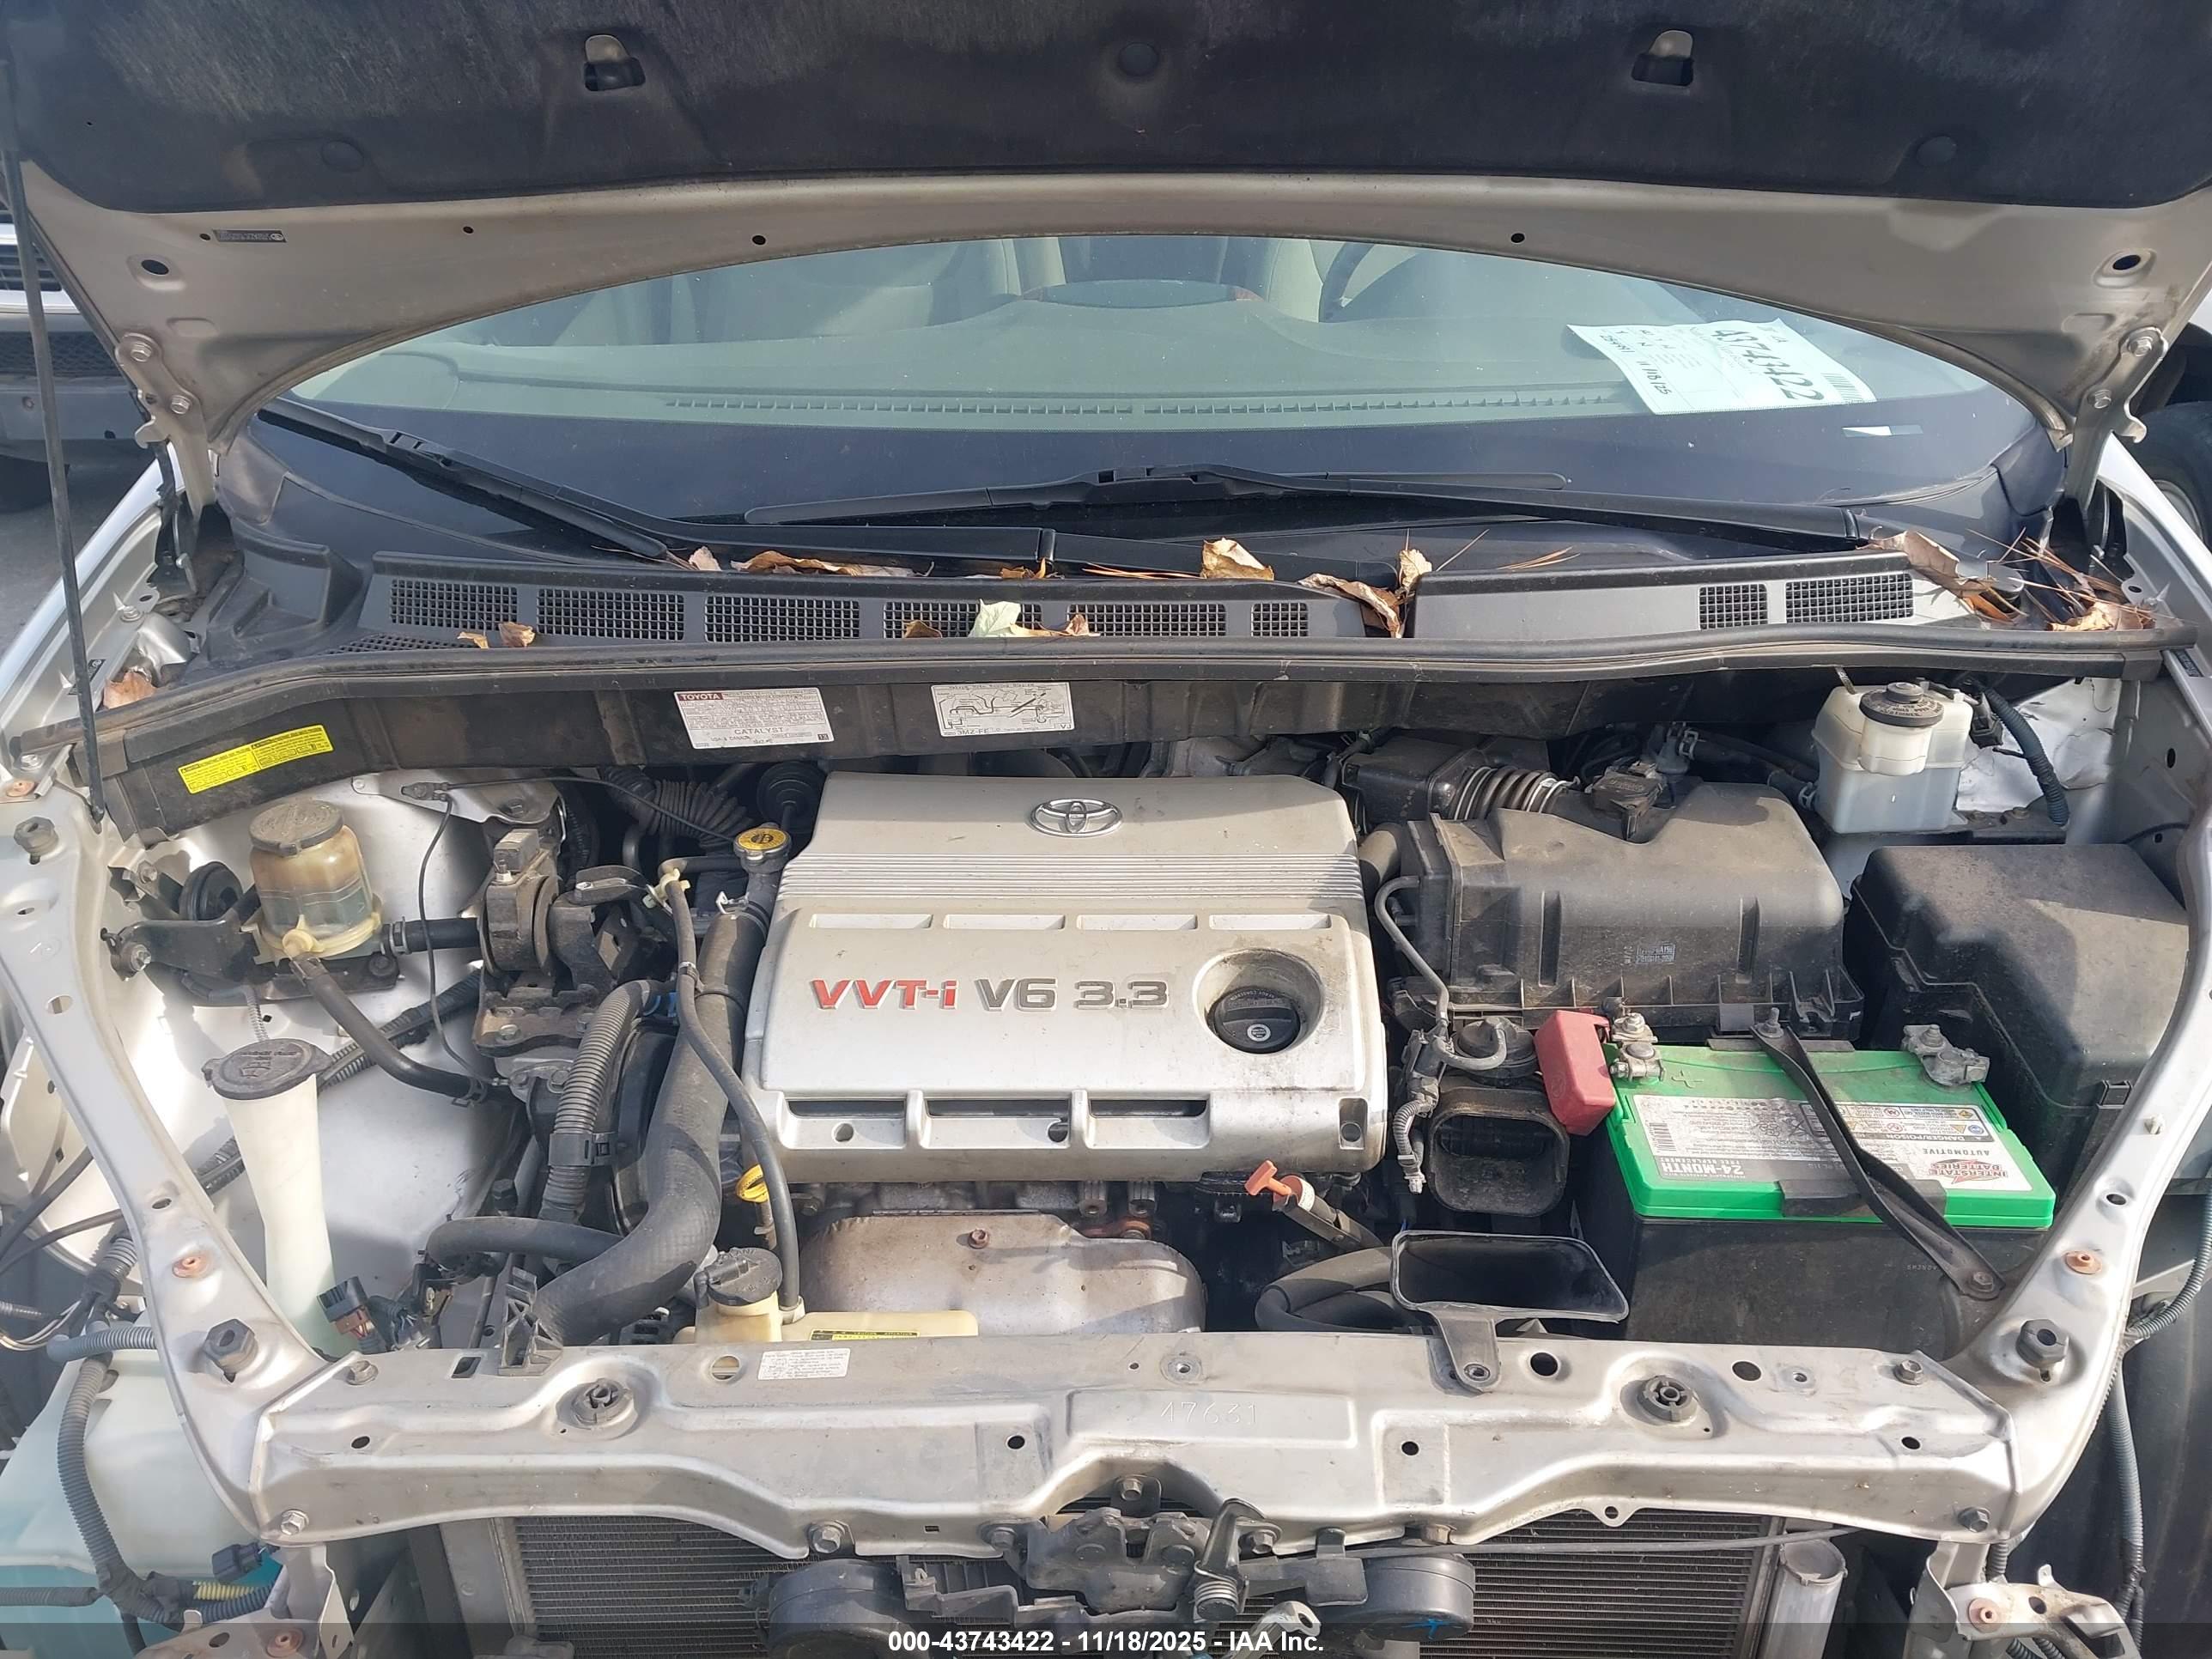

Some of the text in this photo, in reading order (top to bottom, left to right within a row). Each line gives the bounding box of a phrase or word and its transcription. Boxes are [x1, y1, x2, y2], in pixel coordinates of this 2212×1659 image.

[1711, 330, 1825, 401] 43743422
[734, 726, 784, 735] CATALYST
[810, 978, 1170, 1012] VVT-i V6 3.3
[1661, 1162, 1745, 1176] 24-MONTH
[1934, 1162, 2001, 1170] BATTERIES
[1929, 1168, 2008, 1177] INTERSTATE
